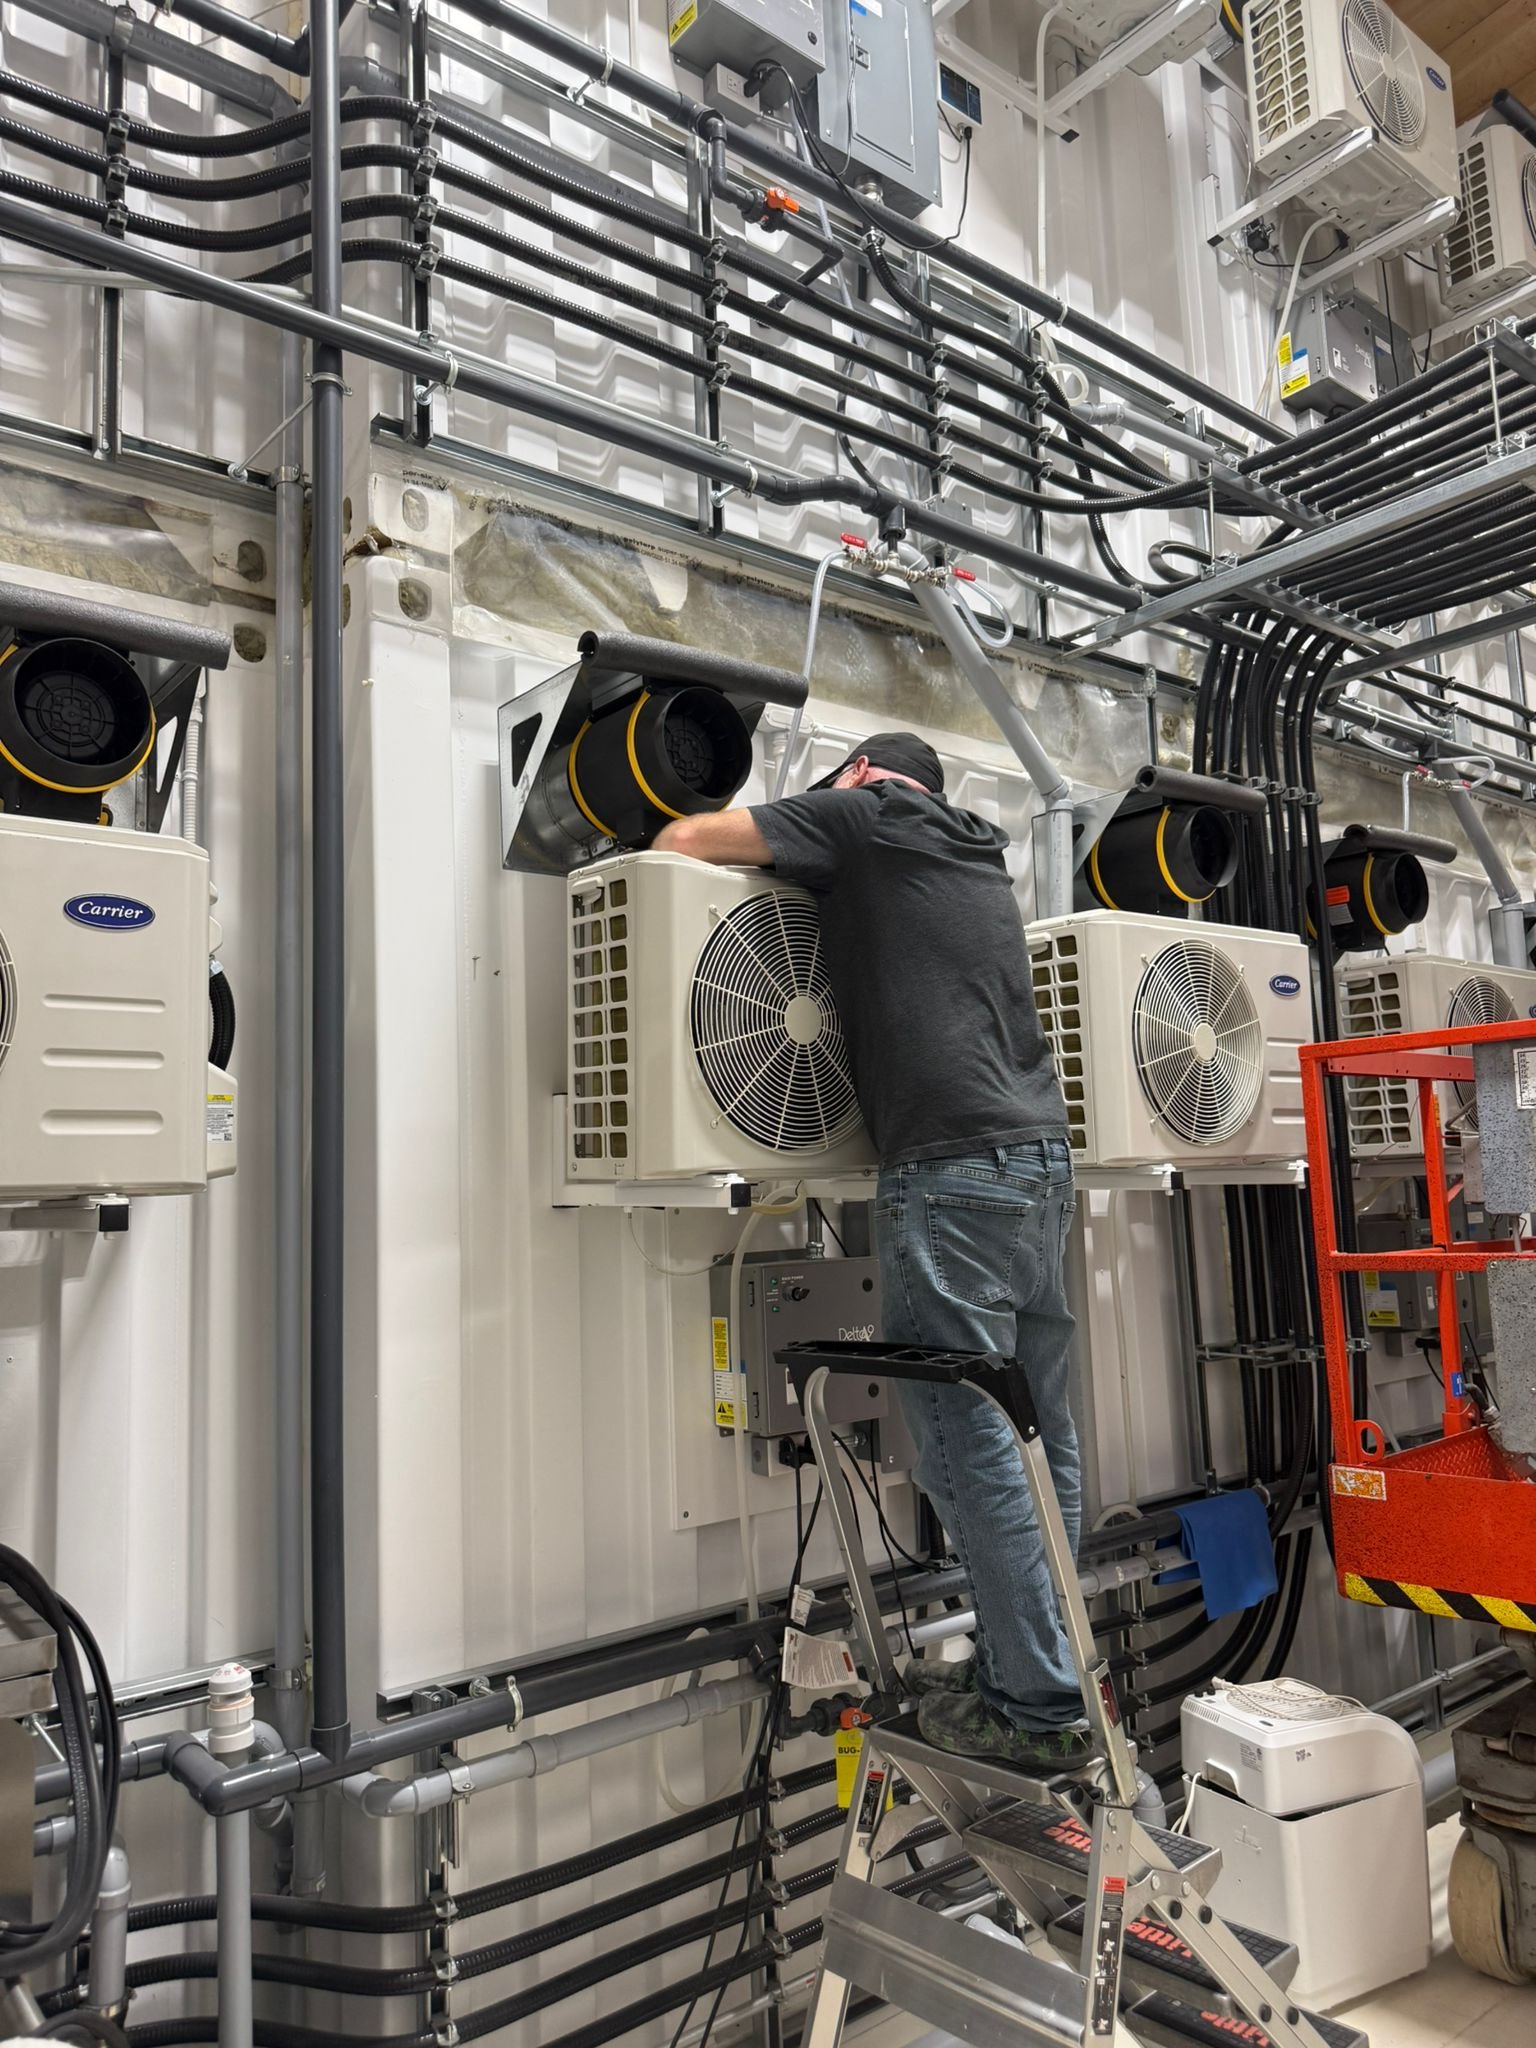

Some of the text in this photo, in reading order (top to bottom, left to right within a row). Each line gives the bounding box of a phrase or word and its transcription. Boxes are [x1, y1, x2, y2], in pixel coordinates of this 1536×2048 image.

[78, 901, 143, 919] Carrier
[1275, 978, 1298, 989] Carrier
[838, 1746, 863, 1754] BUG-
